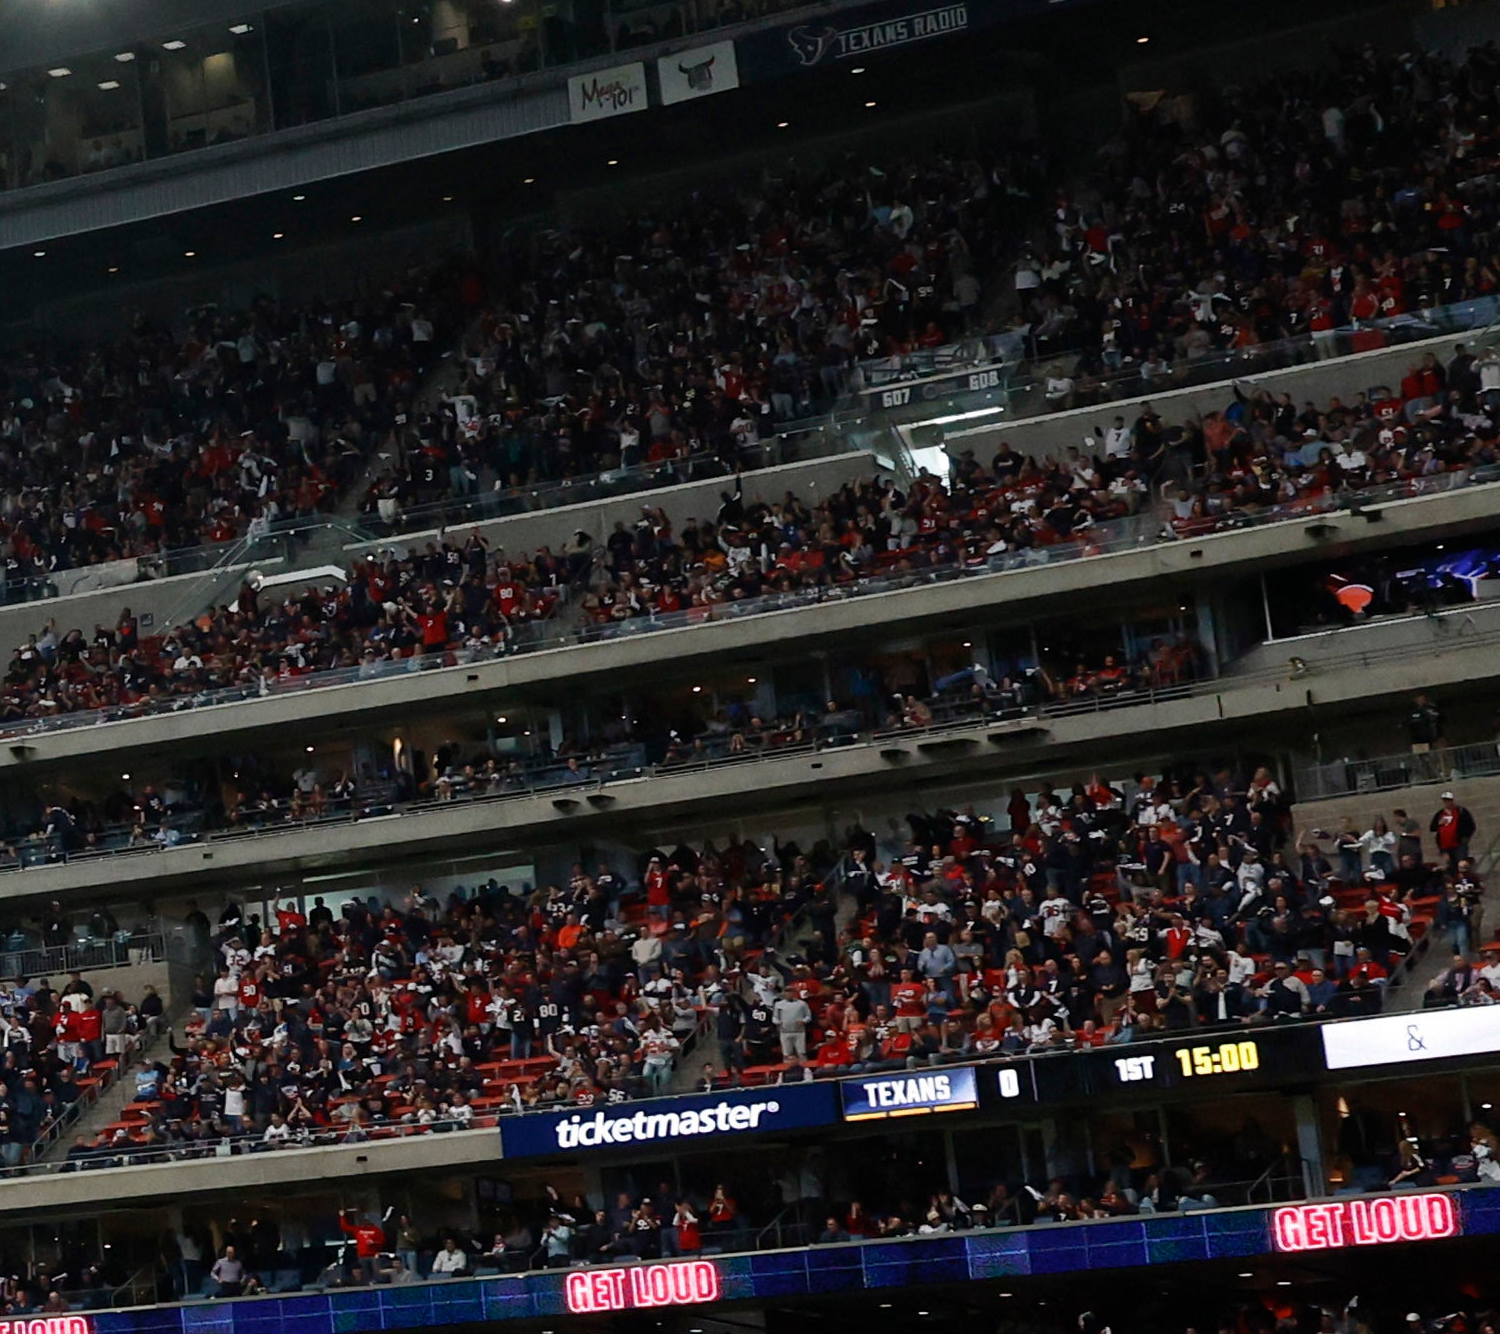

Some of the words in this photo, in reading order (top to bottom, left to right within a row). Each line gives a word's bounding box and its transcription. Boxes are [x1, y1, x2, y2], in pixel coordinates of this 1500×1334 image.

[838, 20, 909, 53] TEXANS
[913, 7, 968, 37] RADIO
[539, 1004, 558, 1017] 80
[1406, 1024, 1428, 1052] &
[1117, 1055, 1155, 1083] 1ST
[1176, 1041, 1258, 1079] 15:00
[864, 1075, 952, 1109] TEXANS
[1000, 1067, 1019, 1098] 0
[1275, 1204, 1344, 1251] GET
[1350, 1194, 1453, 1244] LOUD
[567, 1269, 625, 1312] GET
[631, 1262, 717, 1306] LOUD
